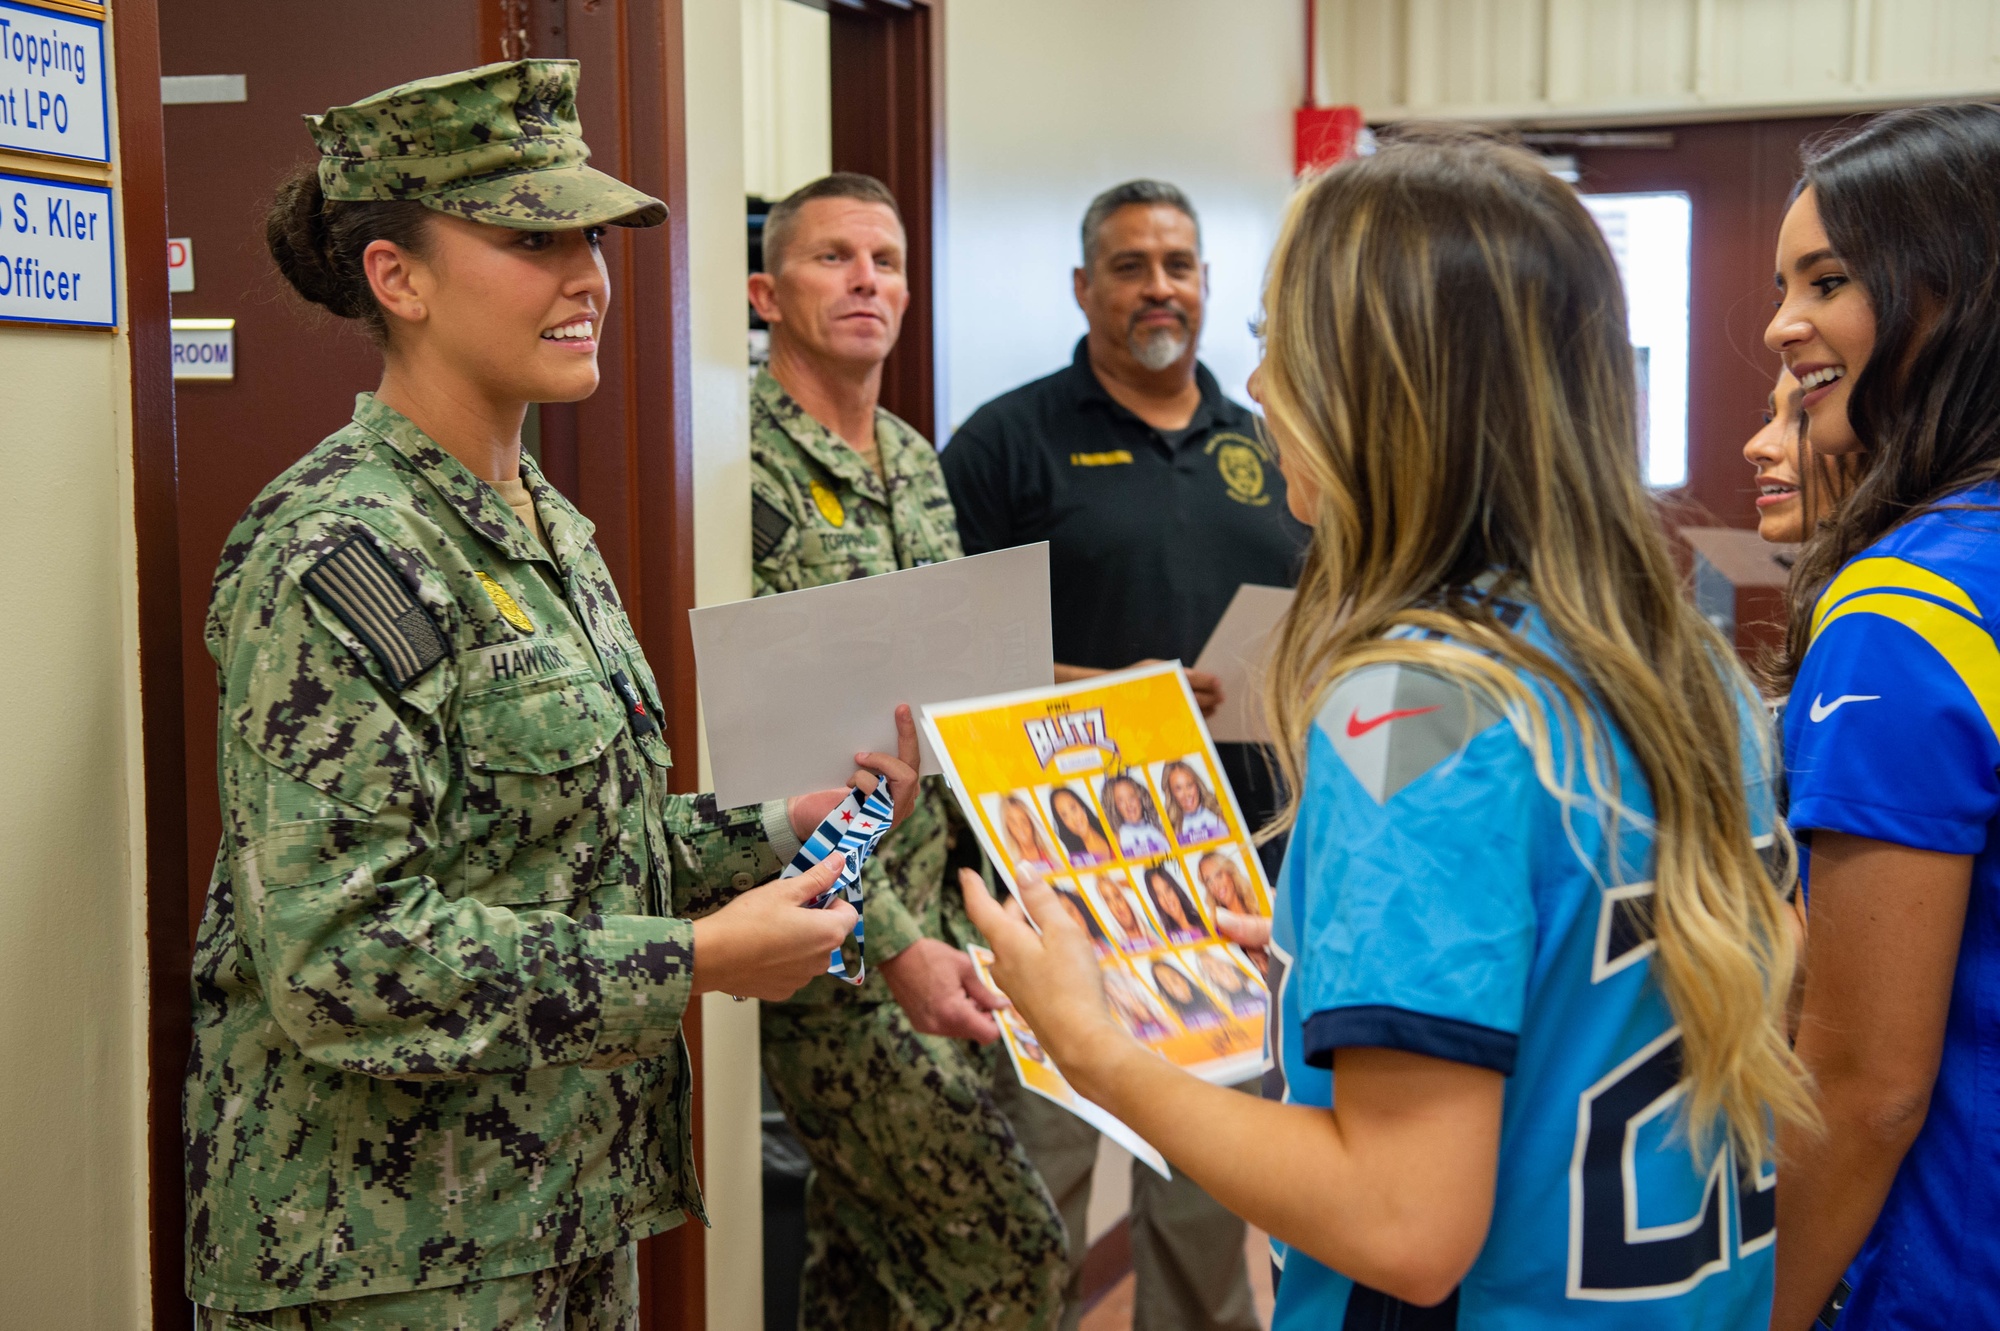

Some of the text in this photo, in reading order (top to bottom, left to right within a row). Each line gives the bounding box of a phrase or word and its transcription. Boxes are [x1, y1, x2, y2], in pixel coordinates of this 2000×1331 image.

[0, 18, 85, 85] Topping
[24, 88, 68, 134] LPO
[14, 192, 37, 235] S.
[47, 196, 97, 241] Kler
[0, 254, 81, 301] Officer
[173, 343, 228, 363] ROOM
[1023, 706, 1120, 772] BLITZ
